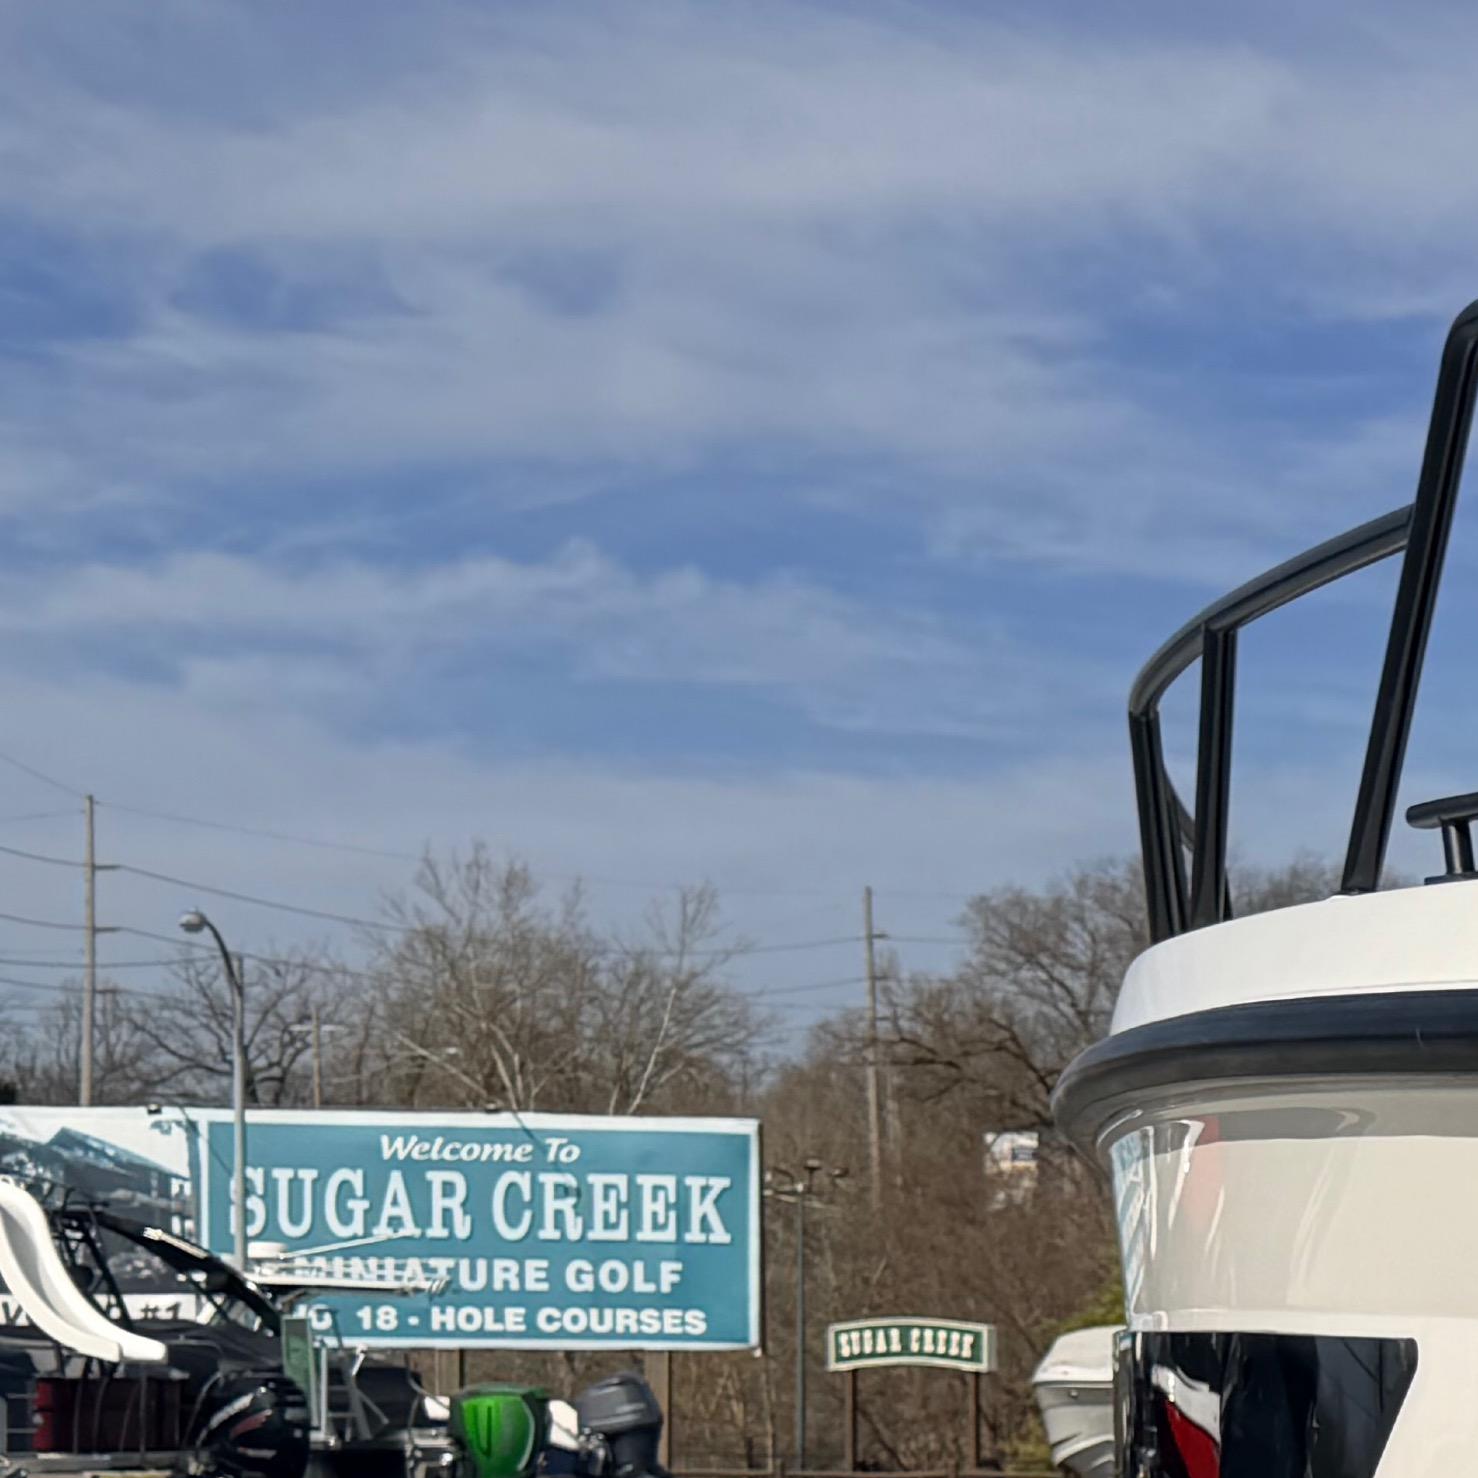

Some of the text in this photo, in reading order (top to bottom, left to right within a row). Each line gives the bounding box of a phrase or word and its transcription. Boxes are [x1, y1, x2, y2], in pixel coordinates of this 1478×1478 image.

[380, 1134, 581, 1163] Welcome To
[230, 1166, 731, 1244] SUGAR CREEK
[565, 1258, 683, 1294] GOLF
[356, 1305, 399, 1332] 18
[431, 1306, 526, 1333] HOLE
[536, 1307, 707, 1336] COURSES
